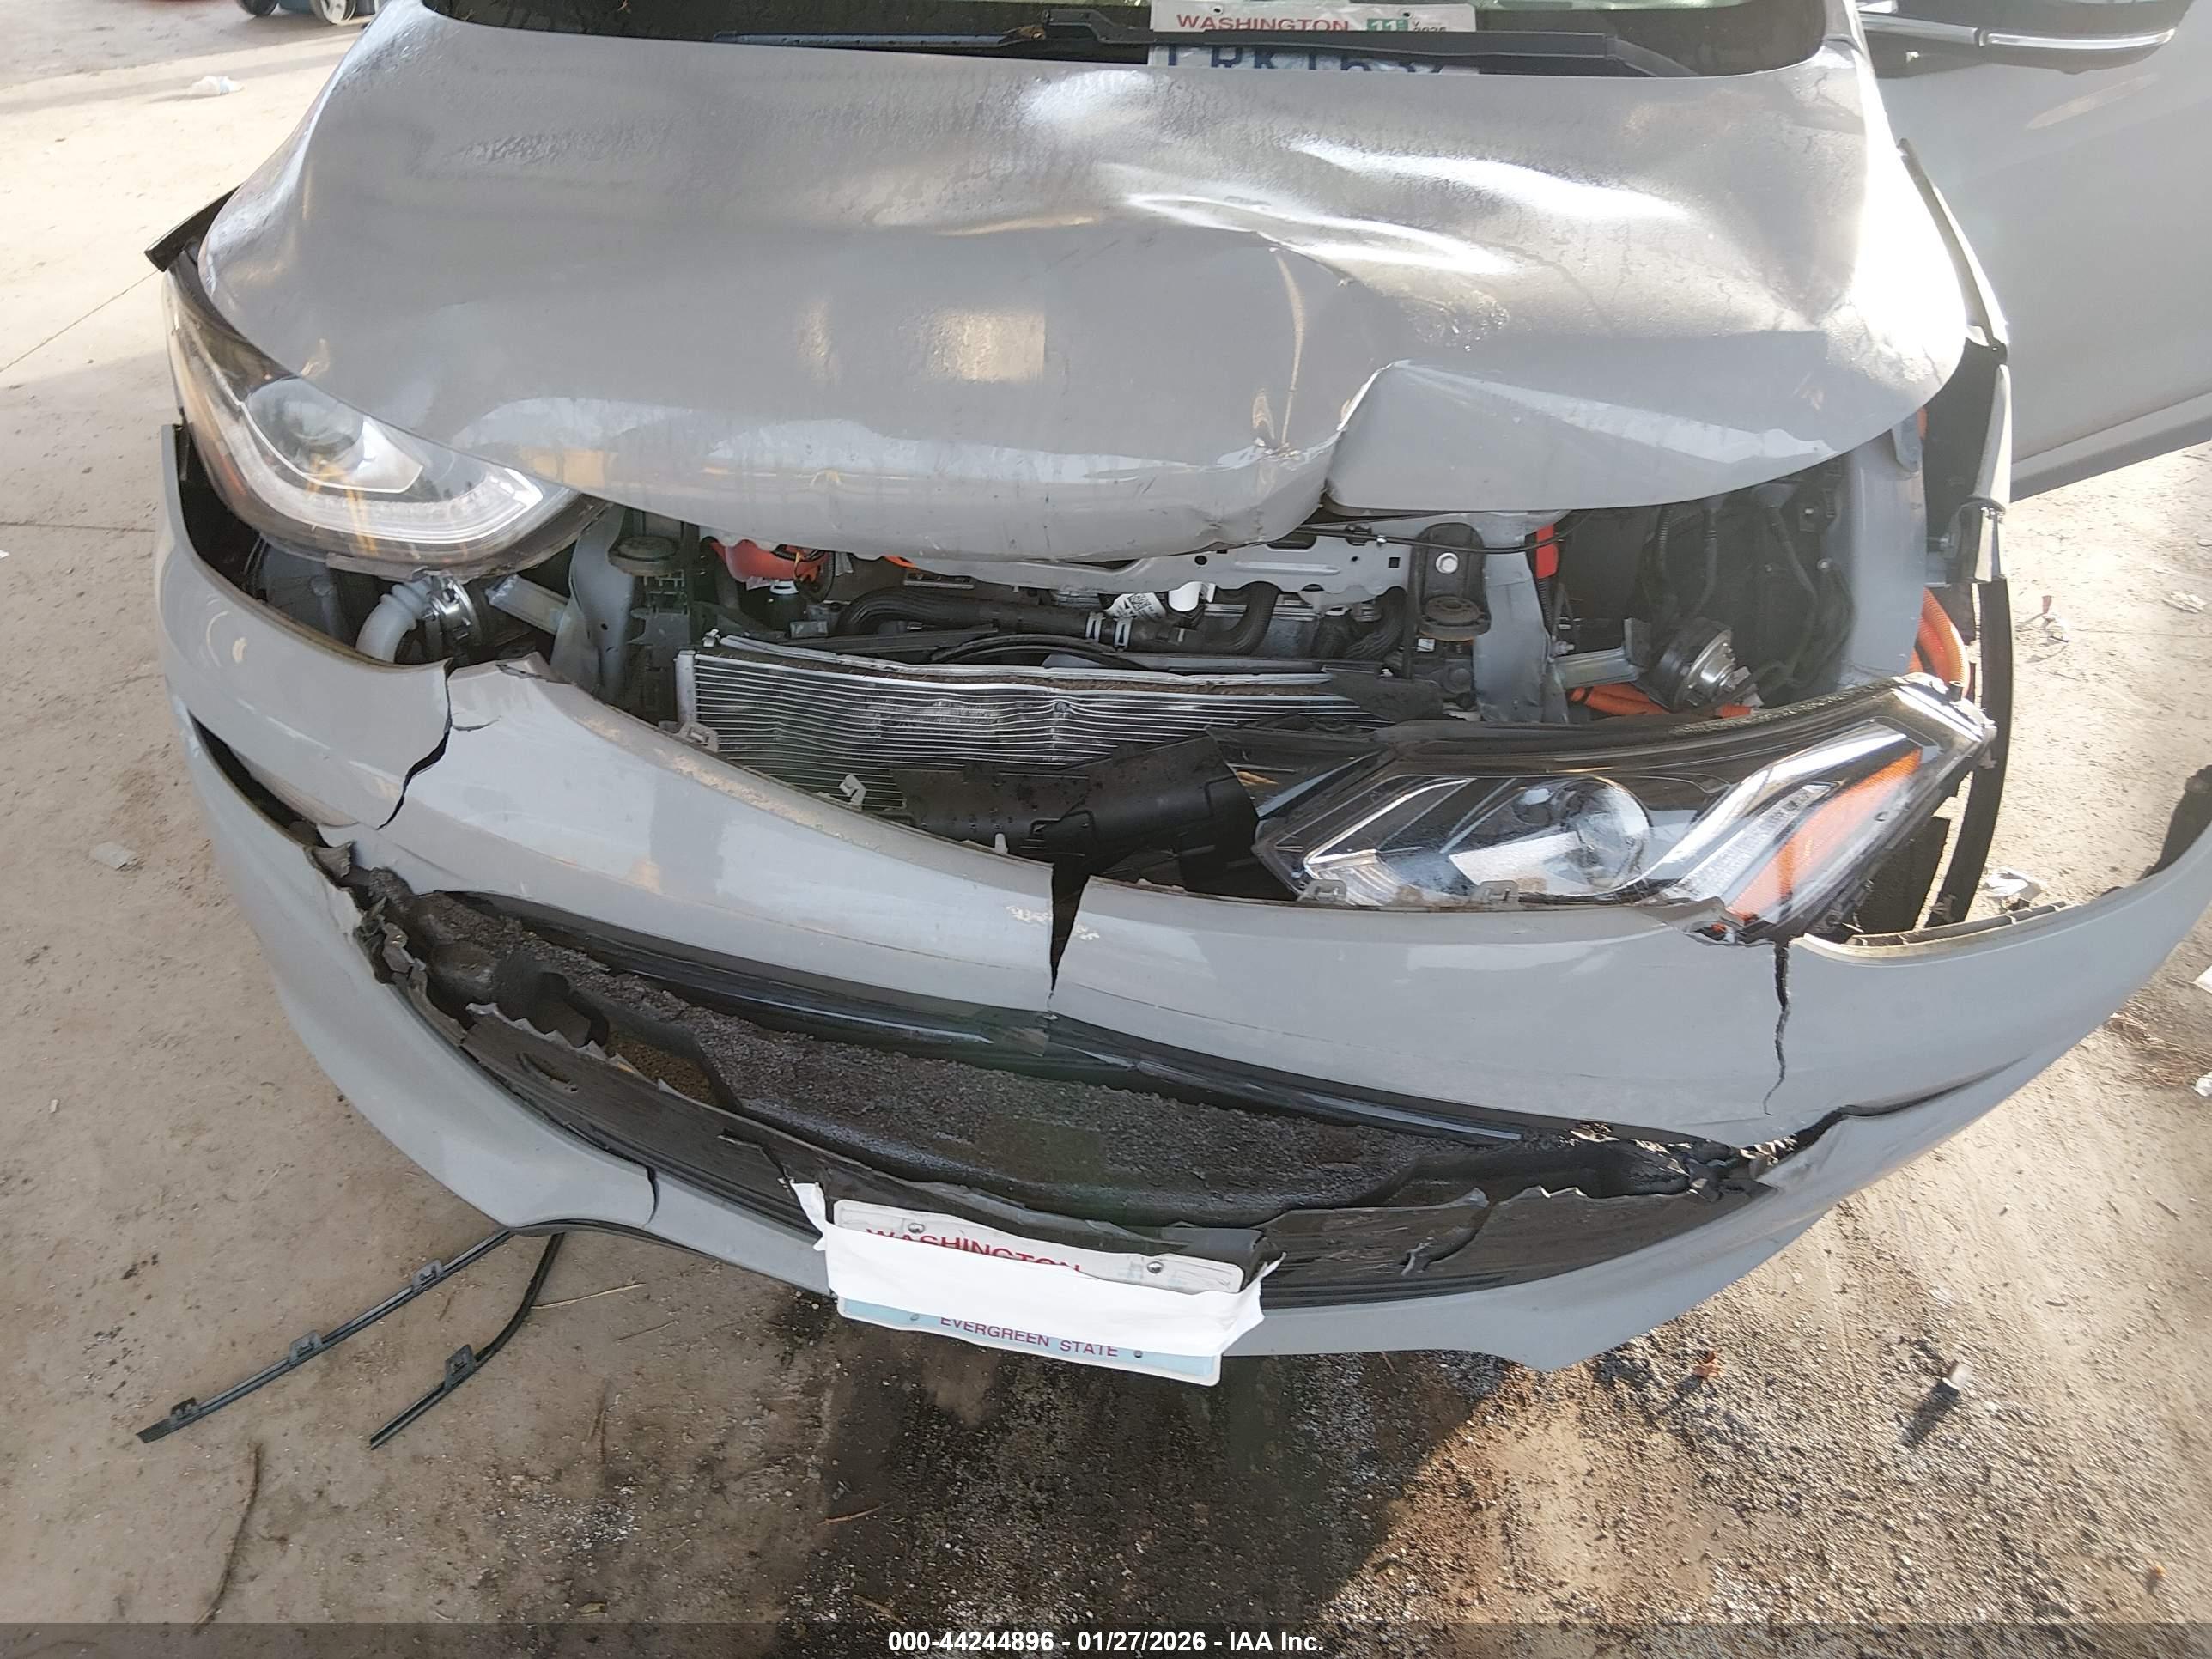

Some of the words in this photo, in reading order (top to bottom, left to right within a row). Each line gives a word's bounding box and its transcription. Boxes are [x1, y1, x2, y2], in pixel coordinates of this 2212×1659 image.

[1176, 14, 1349, 31] WASHINGTON
[940, 1317, 1049, 1347] EVERGREEN
[1060, 1340, 1119, 1358] STATE
